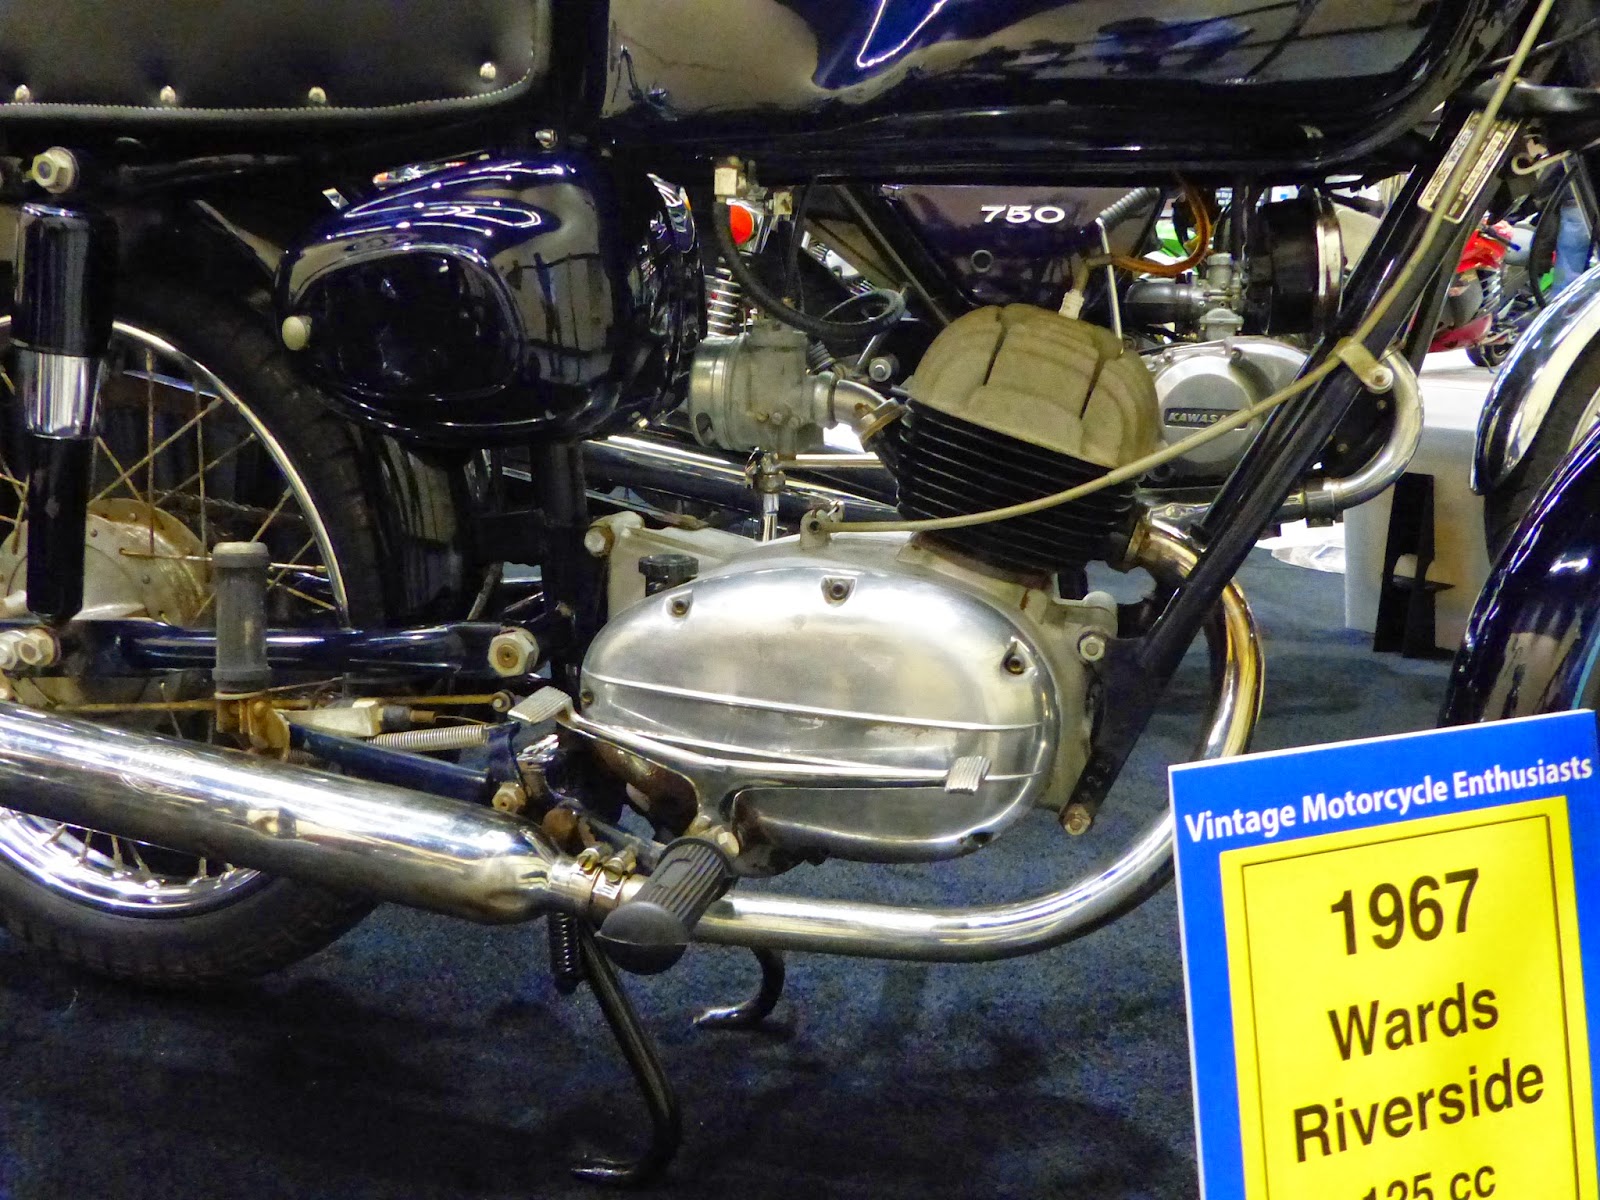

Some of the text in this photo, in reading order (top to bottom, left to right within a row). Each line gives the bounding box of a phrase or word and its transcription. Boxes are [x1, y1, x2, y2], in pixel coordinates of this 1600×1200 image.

[980, 204, 1066, 224] 750
[1167, 411, 1231, 424] KAWASA
[1185, 755, 1594, 842] Vintage Motorcycle Enthusiasts
[1331, 867, 1480, 956] 1967
[1328, 982, 1500, 1061] Wards
[1293, 1057, 1545, 1164] Riverside
[1449, 1165, 1497, 1200] cc
